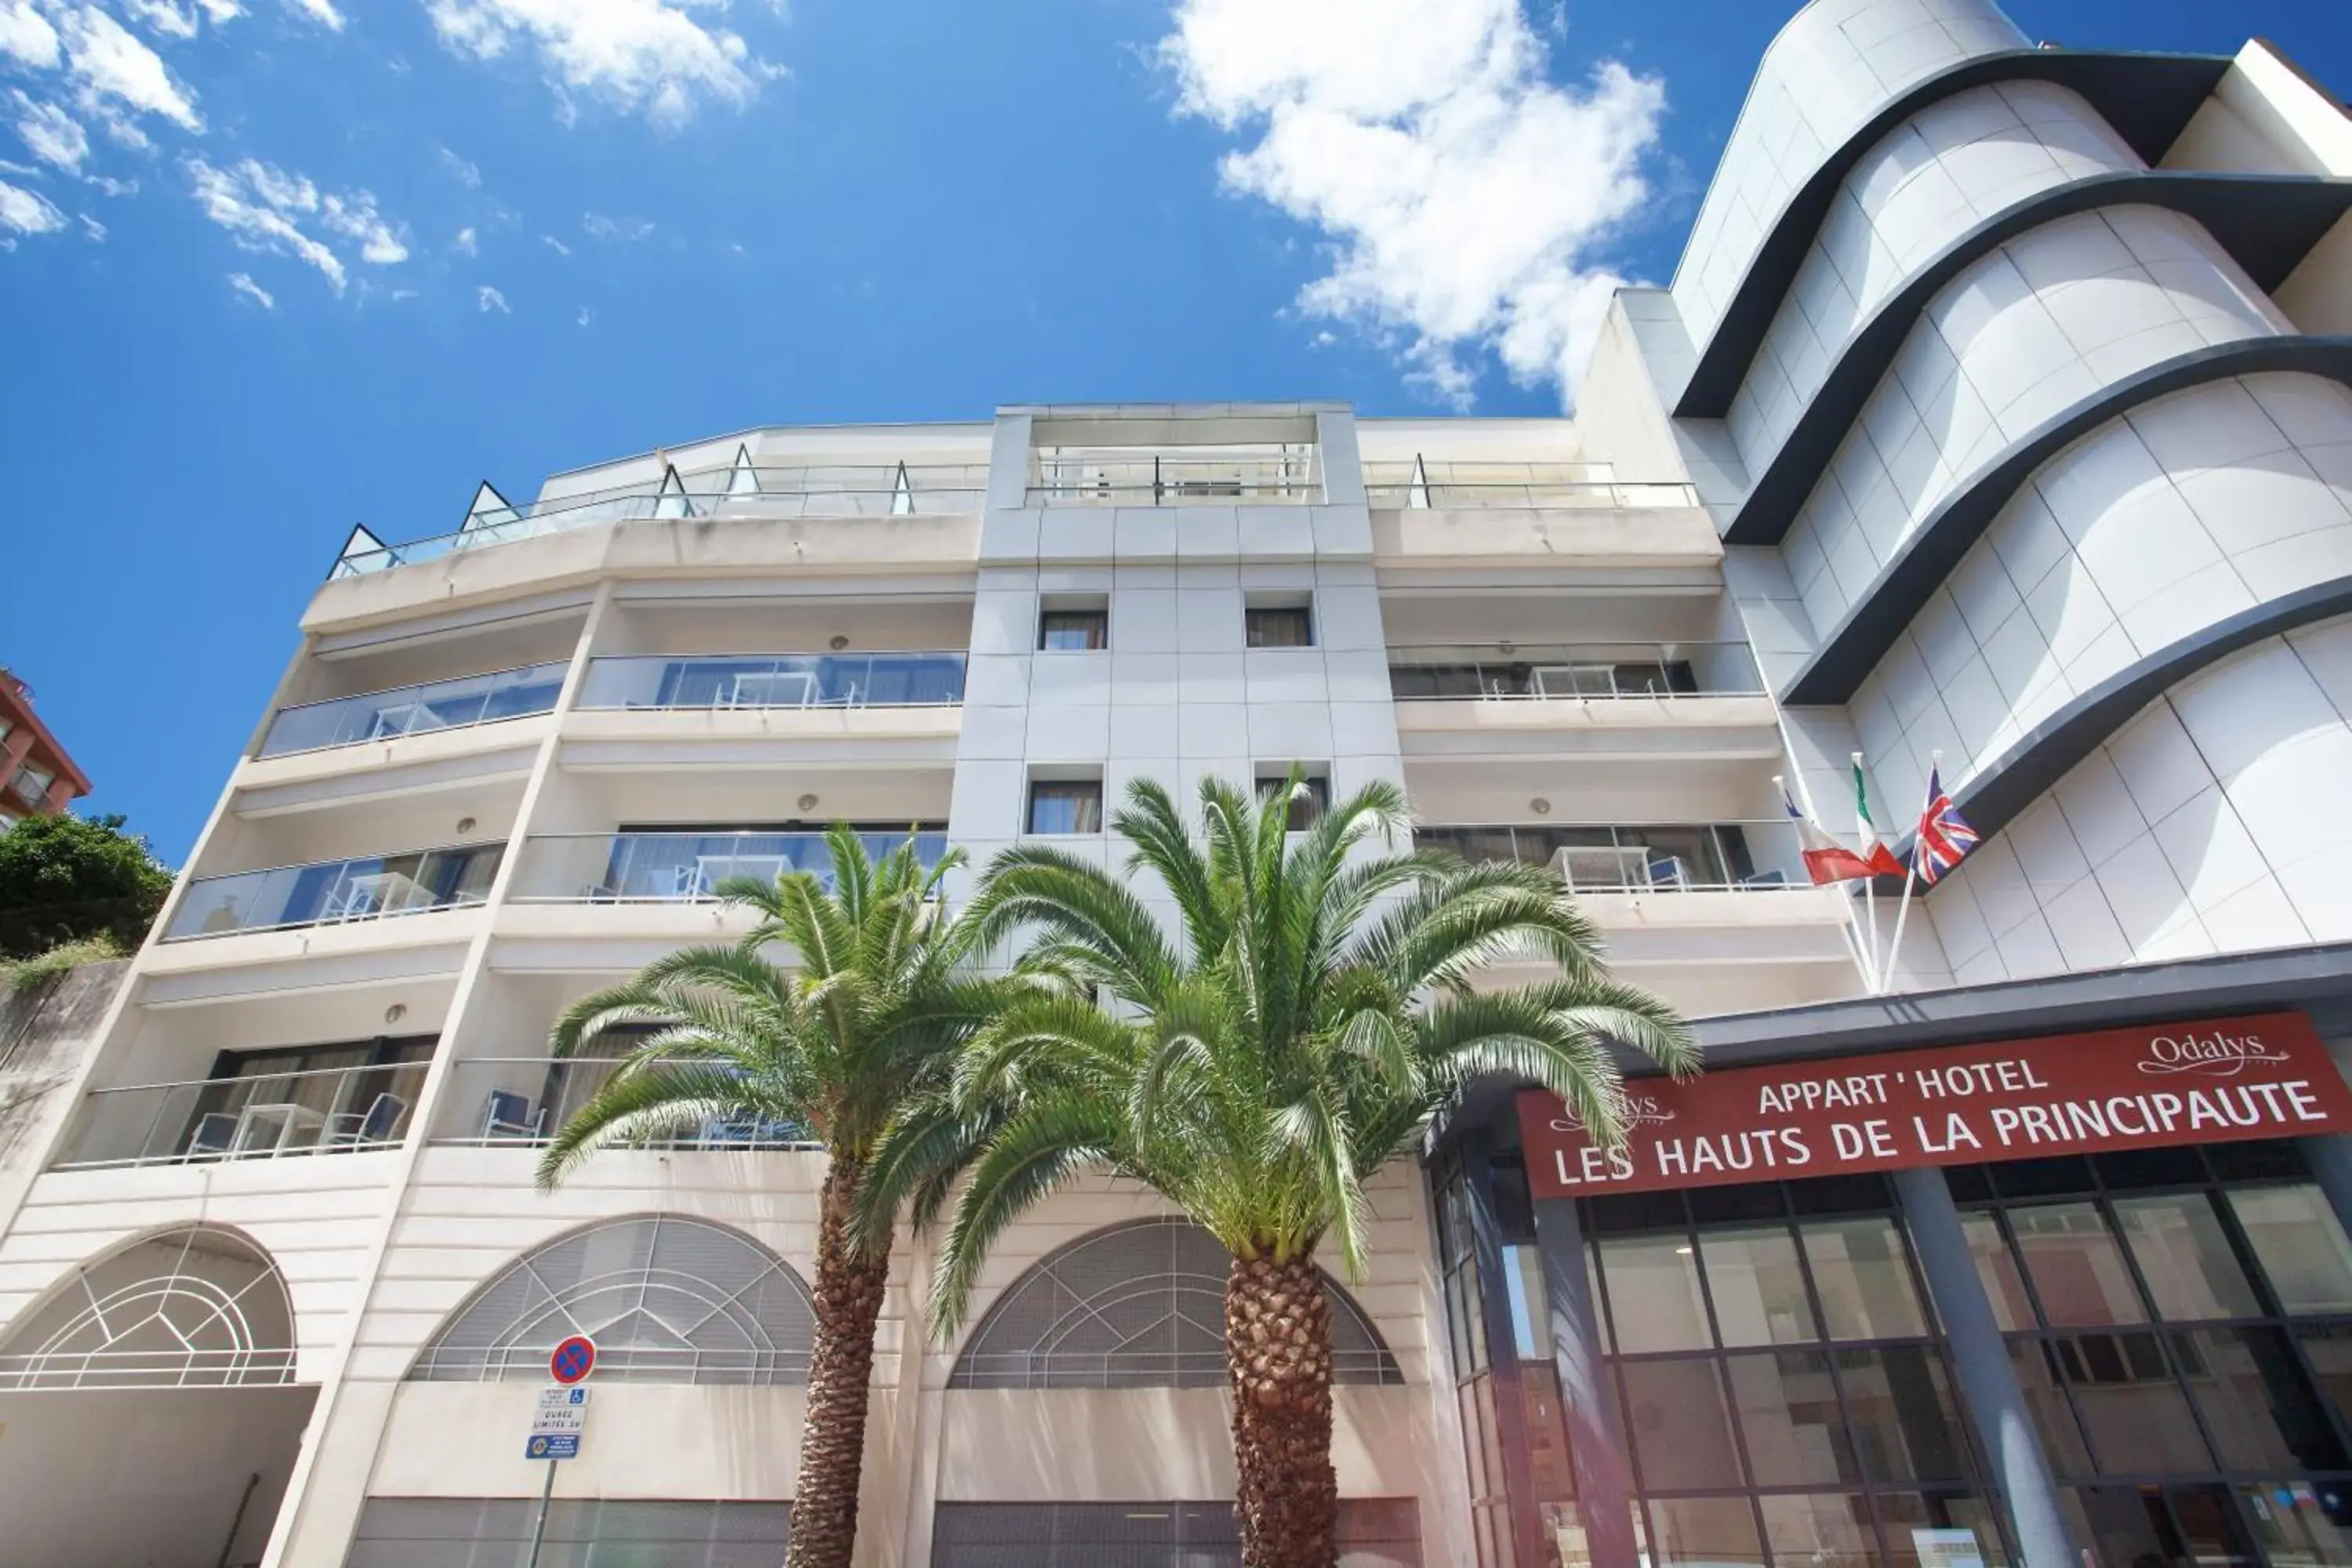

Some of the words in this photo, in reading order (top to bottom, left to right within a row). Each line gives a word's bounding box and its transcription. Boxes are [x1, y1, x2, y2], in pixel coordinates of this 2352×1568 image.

[2150, 1031, 2265, 1076] Odalys
[1555, 1145, 1635, 1185] LES
[1654, 1127, 1811, 1176] HAUTS
[1831, 1119, 1898, 1161] DE
[1913, 1112, 1982, 1154] LA
[1990, 1080, 2328, 1147] PRINCIPAUTE
